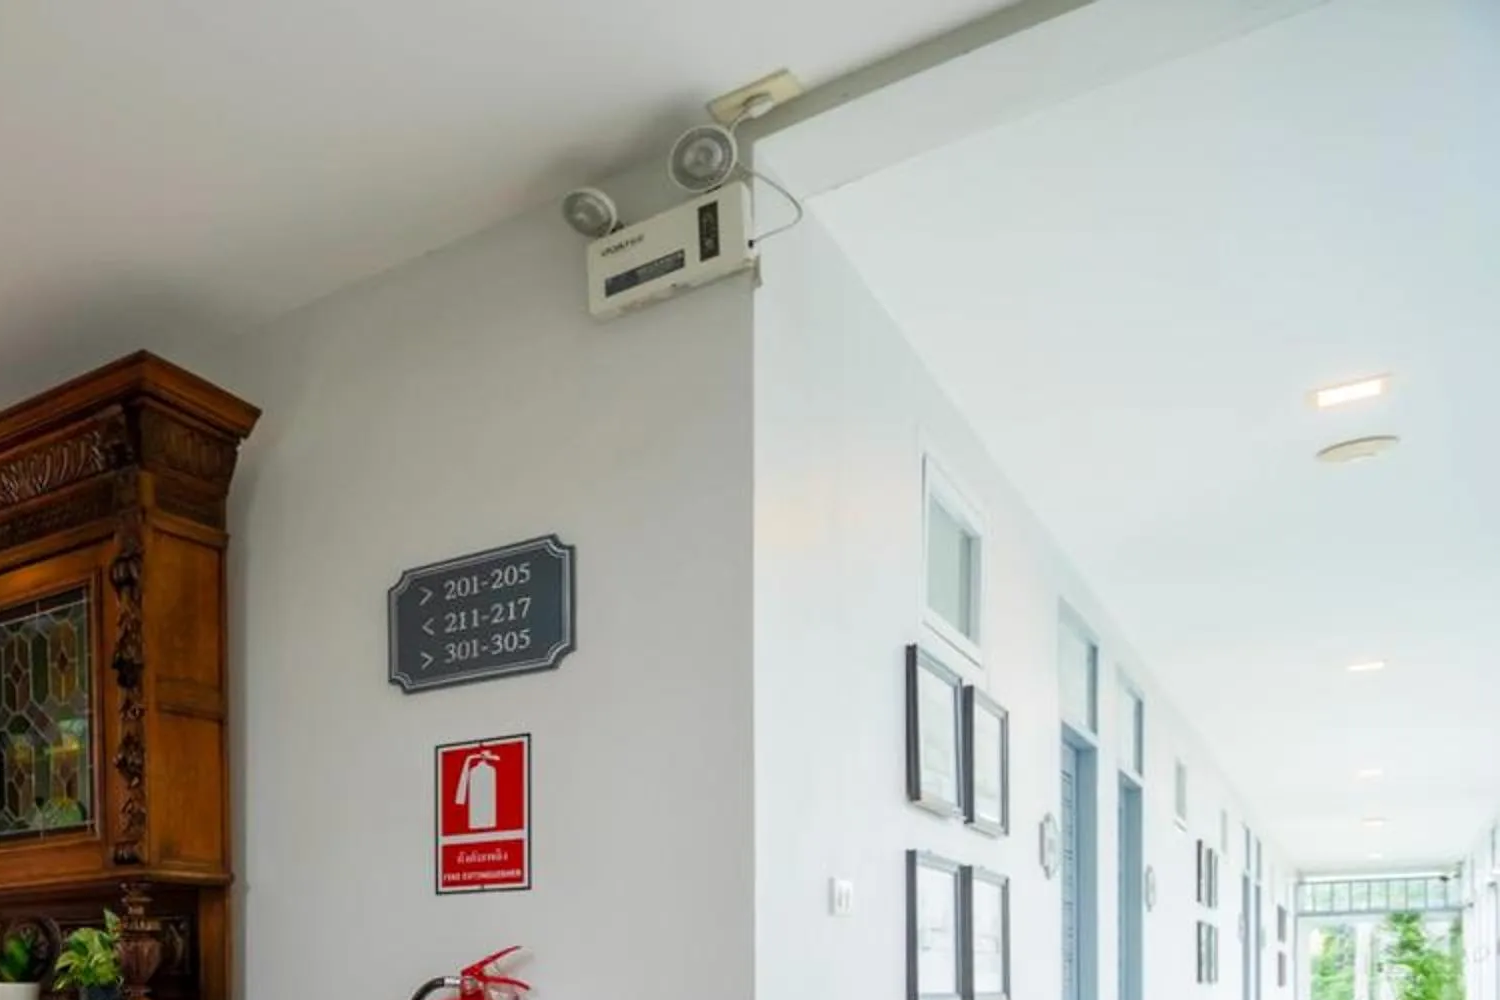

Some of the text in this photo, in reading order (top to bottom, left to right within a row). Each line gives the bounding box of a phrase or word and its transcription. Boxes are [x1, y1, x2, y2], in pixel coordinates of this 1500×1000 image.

[444, 562, 532, 600] 201-205
[444, 597, 532, 633] 211-217
[444, 629, 532, 664] 301-305
